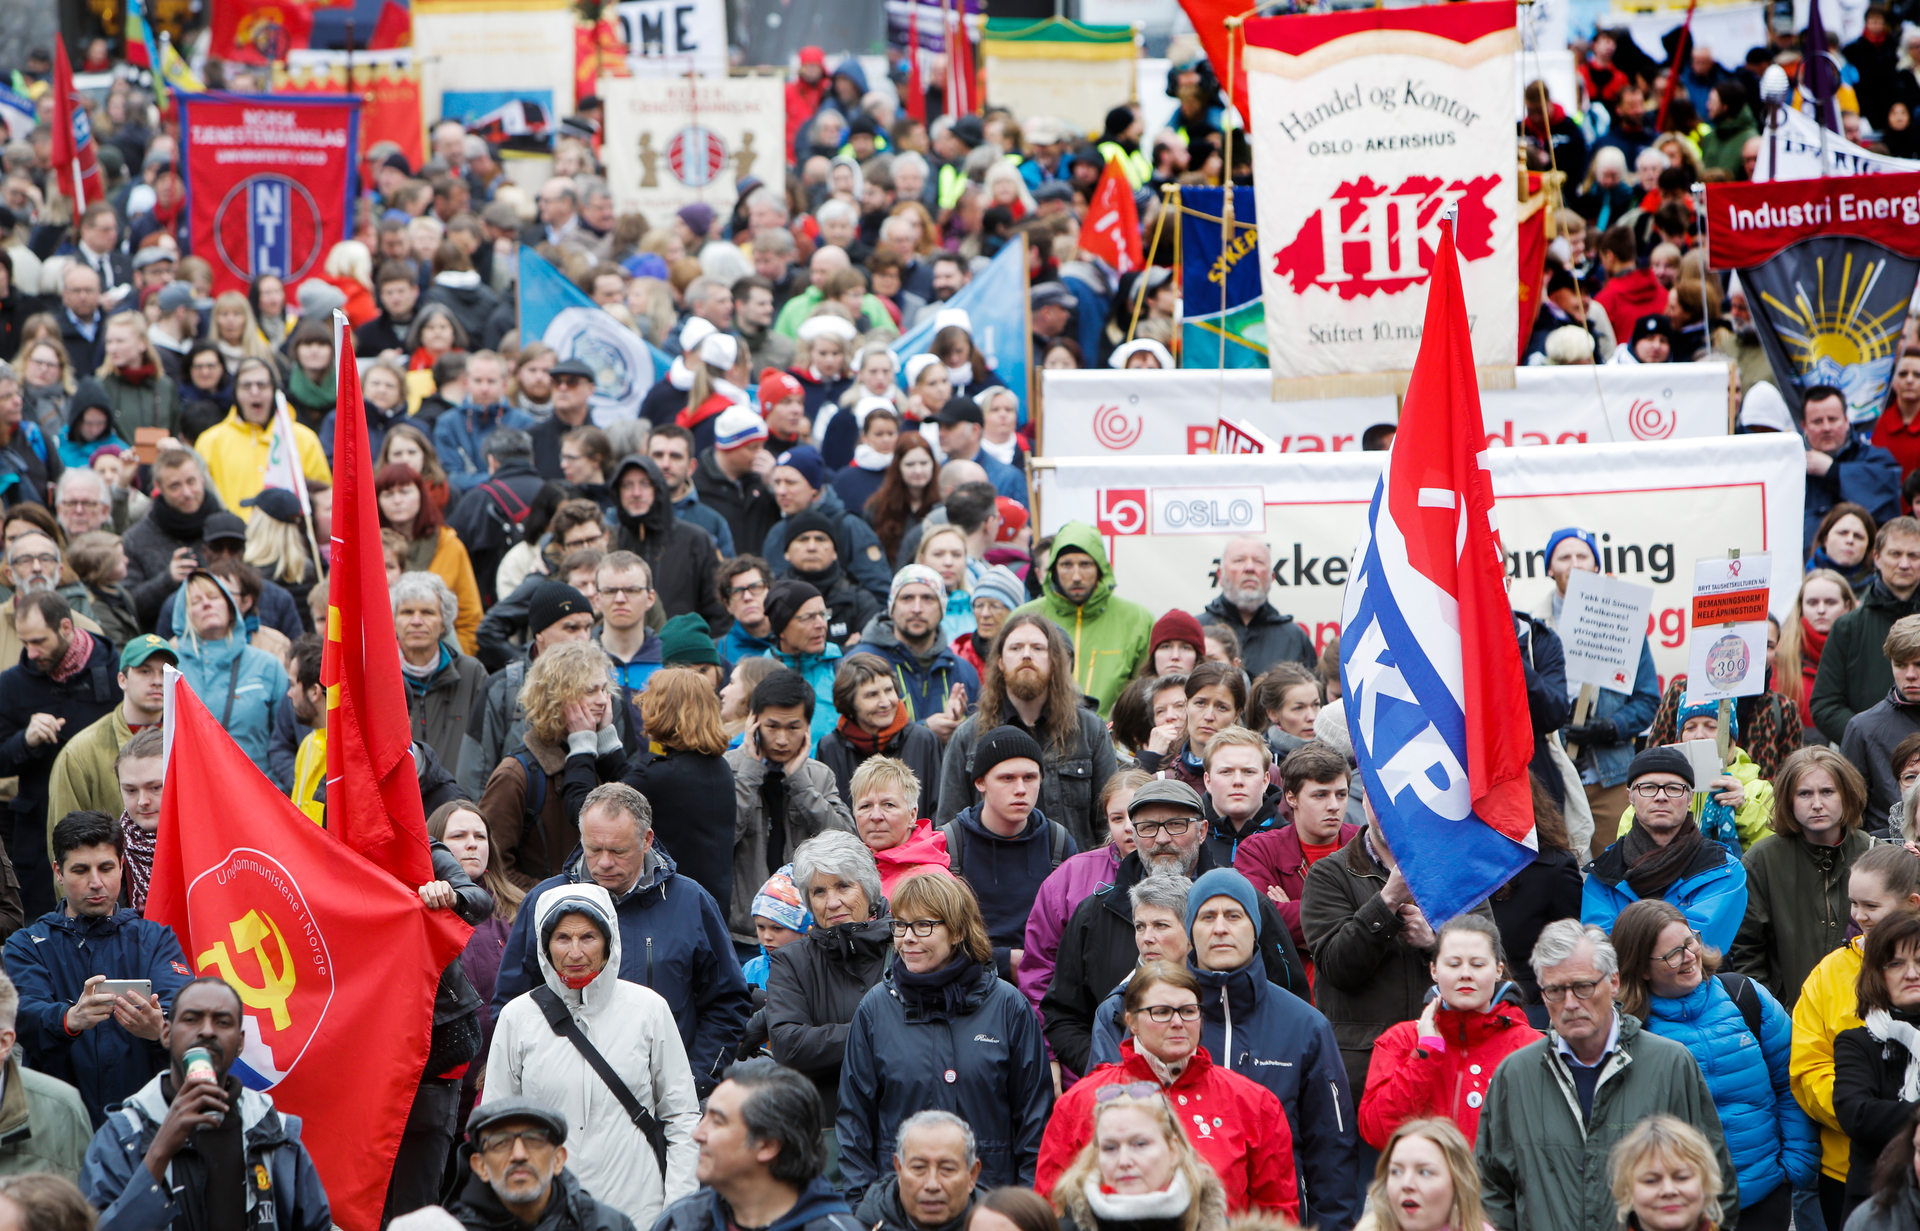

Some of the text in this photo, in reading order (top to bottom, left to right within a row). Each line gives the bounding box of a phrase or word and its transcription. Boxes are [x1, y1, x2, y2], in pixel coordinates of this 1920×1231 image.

[1280, 80, 1480, 141] Handel og Kontor
[1729, 196, 1832, 232] Industri
[256, 182, 283, 276] NTL
[1316, 189, 1468, 282] HK
[1308, 321, 1363, 345] Stiftet
[1164, 499, 1253, 528] OSLO
[1712, 579, 1758, 590] TAUSHETSKULTUREN
[1580, 592, 1639, 612] Takk til Simon
[1698, 594, 1760, 608] BEMANNINGSNORM
[1584, 605, 1630, 620] Malkenes!
[1698, 604, 1764, 619] HELE ÅPNINGSTIDEN!
[1580, 616, 1614, 628] Kampen
[1574, 627, 1626, 643] ytringsfrihet
[1576, 638, 1622, 654] Osloskolen
[1569, 648, 1626, 666] må fortsette!
[1718, 658, 1746, 676] 300
[216, 858, 326, 976] Ungkommunistene i Norge
